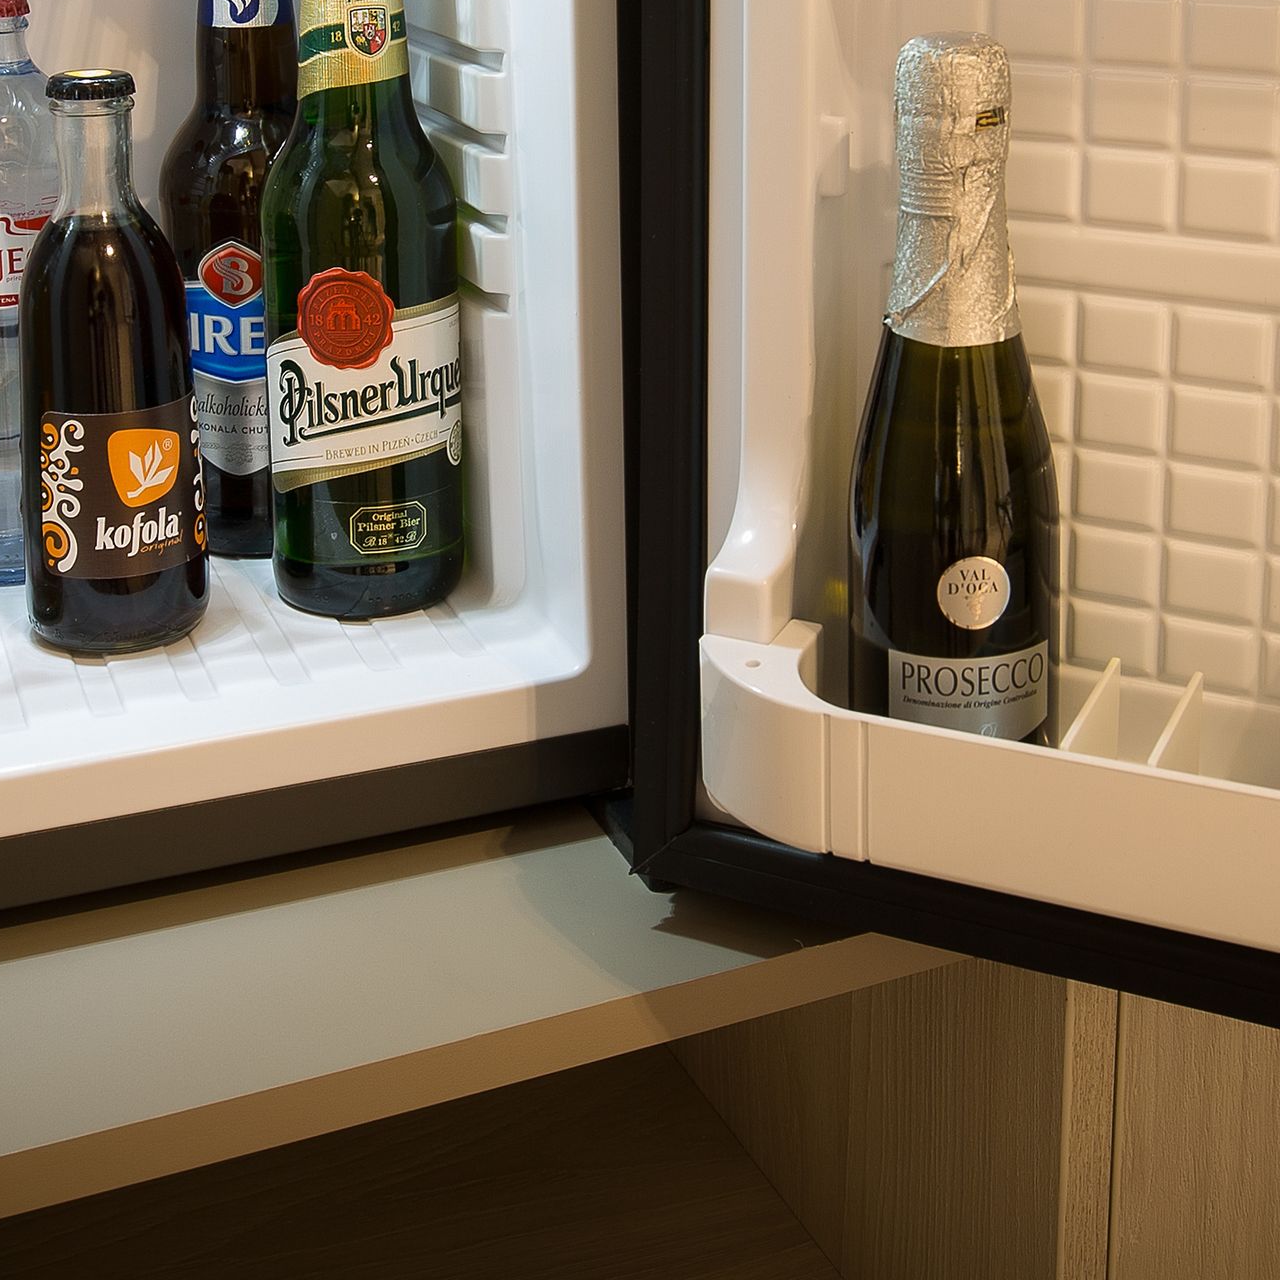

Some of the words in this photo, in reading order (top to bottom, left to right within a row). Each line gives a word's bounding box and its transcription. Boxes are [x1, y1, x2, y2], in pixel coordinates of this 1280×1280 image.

[330, 31, 342, 43] 18
[310, 314, 323, 326] 18
[364, 314, 381, 326] 42
[190, 312, 265, 356] IRE
[197, 393, 269, 417] alkoholick
[279, 359, 396, 447] Pilsner
[389, 356, 461, 419] Urque
[199, 422, 238, 434] KONALÁ
[325, 446, 366, 461] BREWED
[368, 443, 379, 455] IN
[371, 510, 408, 521] Original
[95, 506, 180, 557] kofola
[357, 521, 397, 533] Pilsner
[399, 517, 421, 529] Bier
[141, 529, 184, 556] original
[959, 569, 991, 582] VAL
[948, 582, 999, 595] D'OCA
[901, 652, 1045, 697] PROSECCO
[902, 695, 962, 709] Denominazione
[963, 700, 973, 708] di
[973, 699, 1002, 709] Origine
